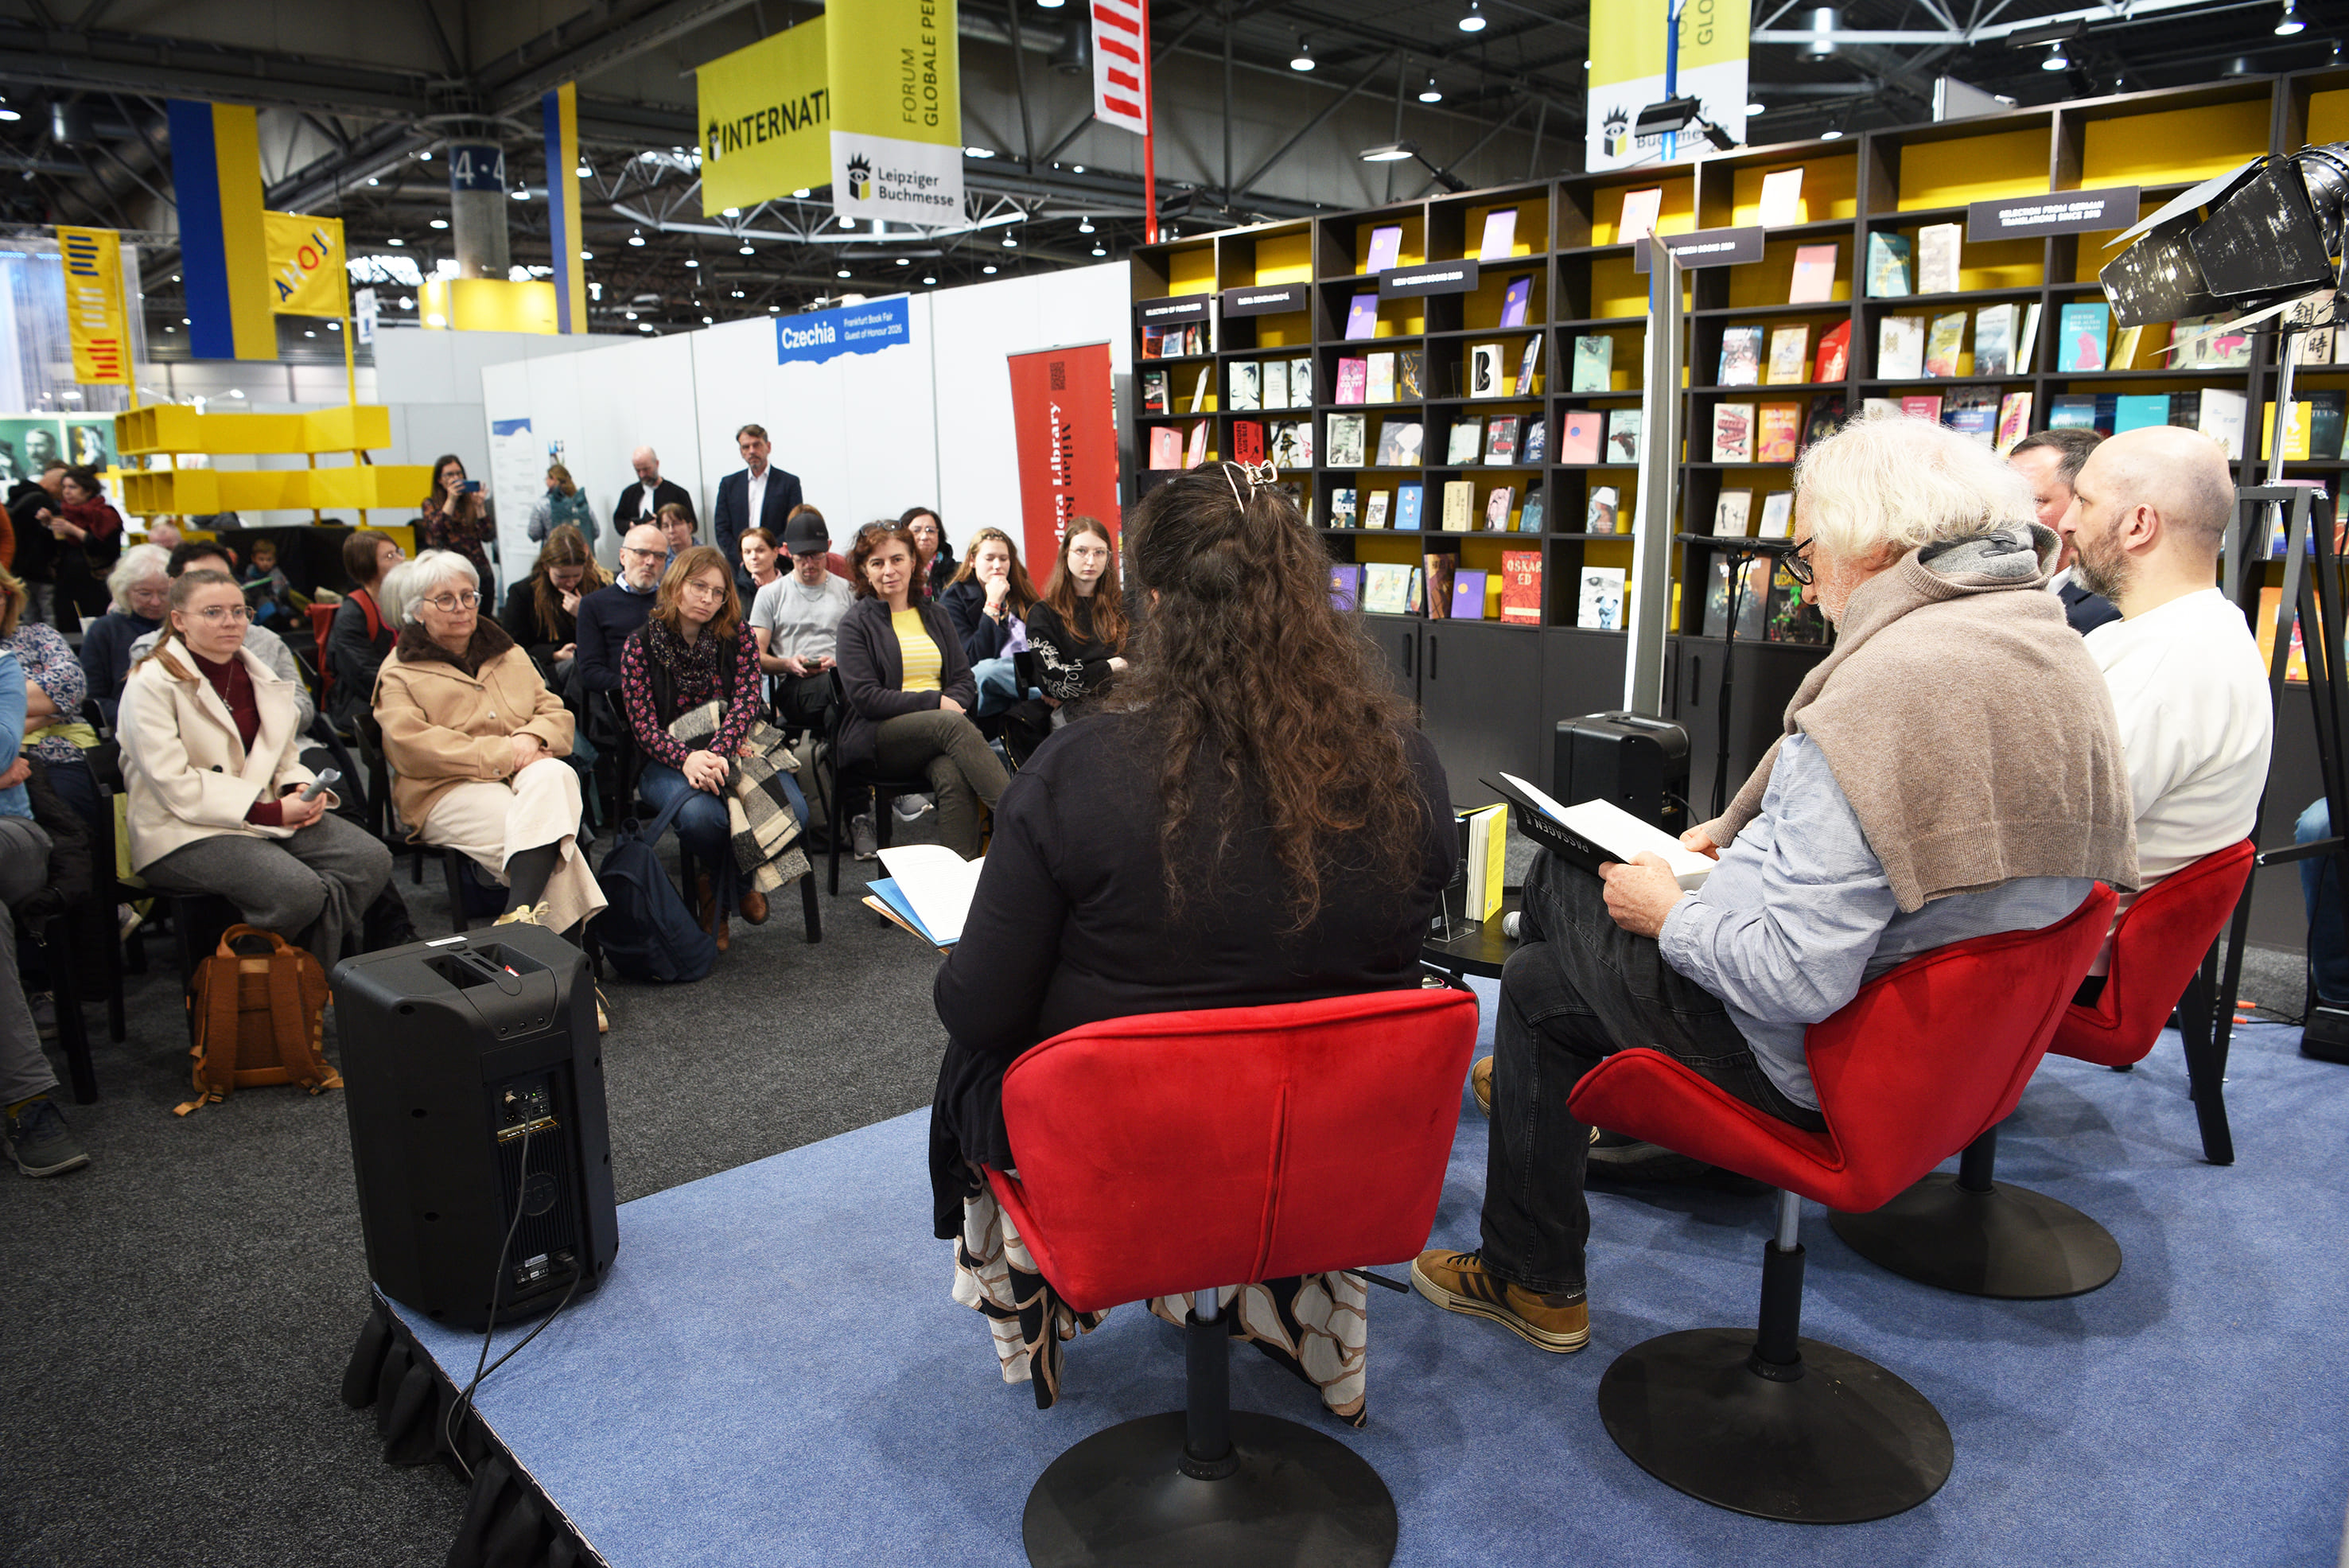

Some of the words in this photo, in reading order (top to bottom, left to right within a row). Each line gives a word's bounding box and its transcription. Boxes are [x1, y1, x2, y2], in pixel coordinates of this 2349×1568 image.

[901, 49, 917, 123] FORUM
[922, 34, 939, 126] GLOBALE
[878, 167, 939, 188] Leipziger
[879, 185, 955, 208] Buchmesse
[868, 313, 882, 325] Book
[882, 311, 893, 322] Fair
[782, 321, 836, 349] Czechia
[844, 330, 861, 341] Guest
[861, 328, 867, 339] of
[1049, 402, 1063, 486] Library
[1061, 422, 1074, 486] Milan
[1507, 559, 1542, 573] OSKAR
[1518, 574, 1532, 586] ED
[1534, 818, 1589, 854] PASSAGEN
